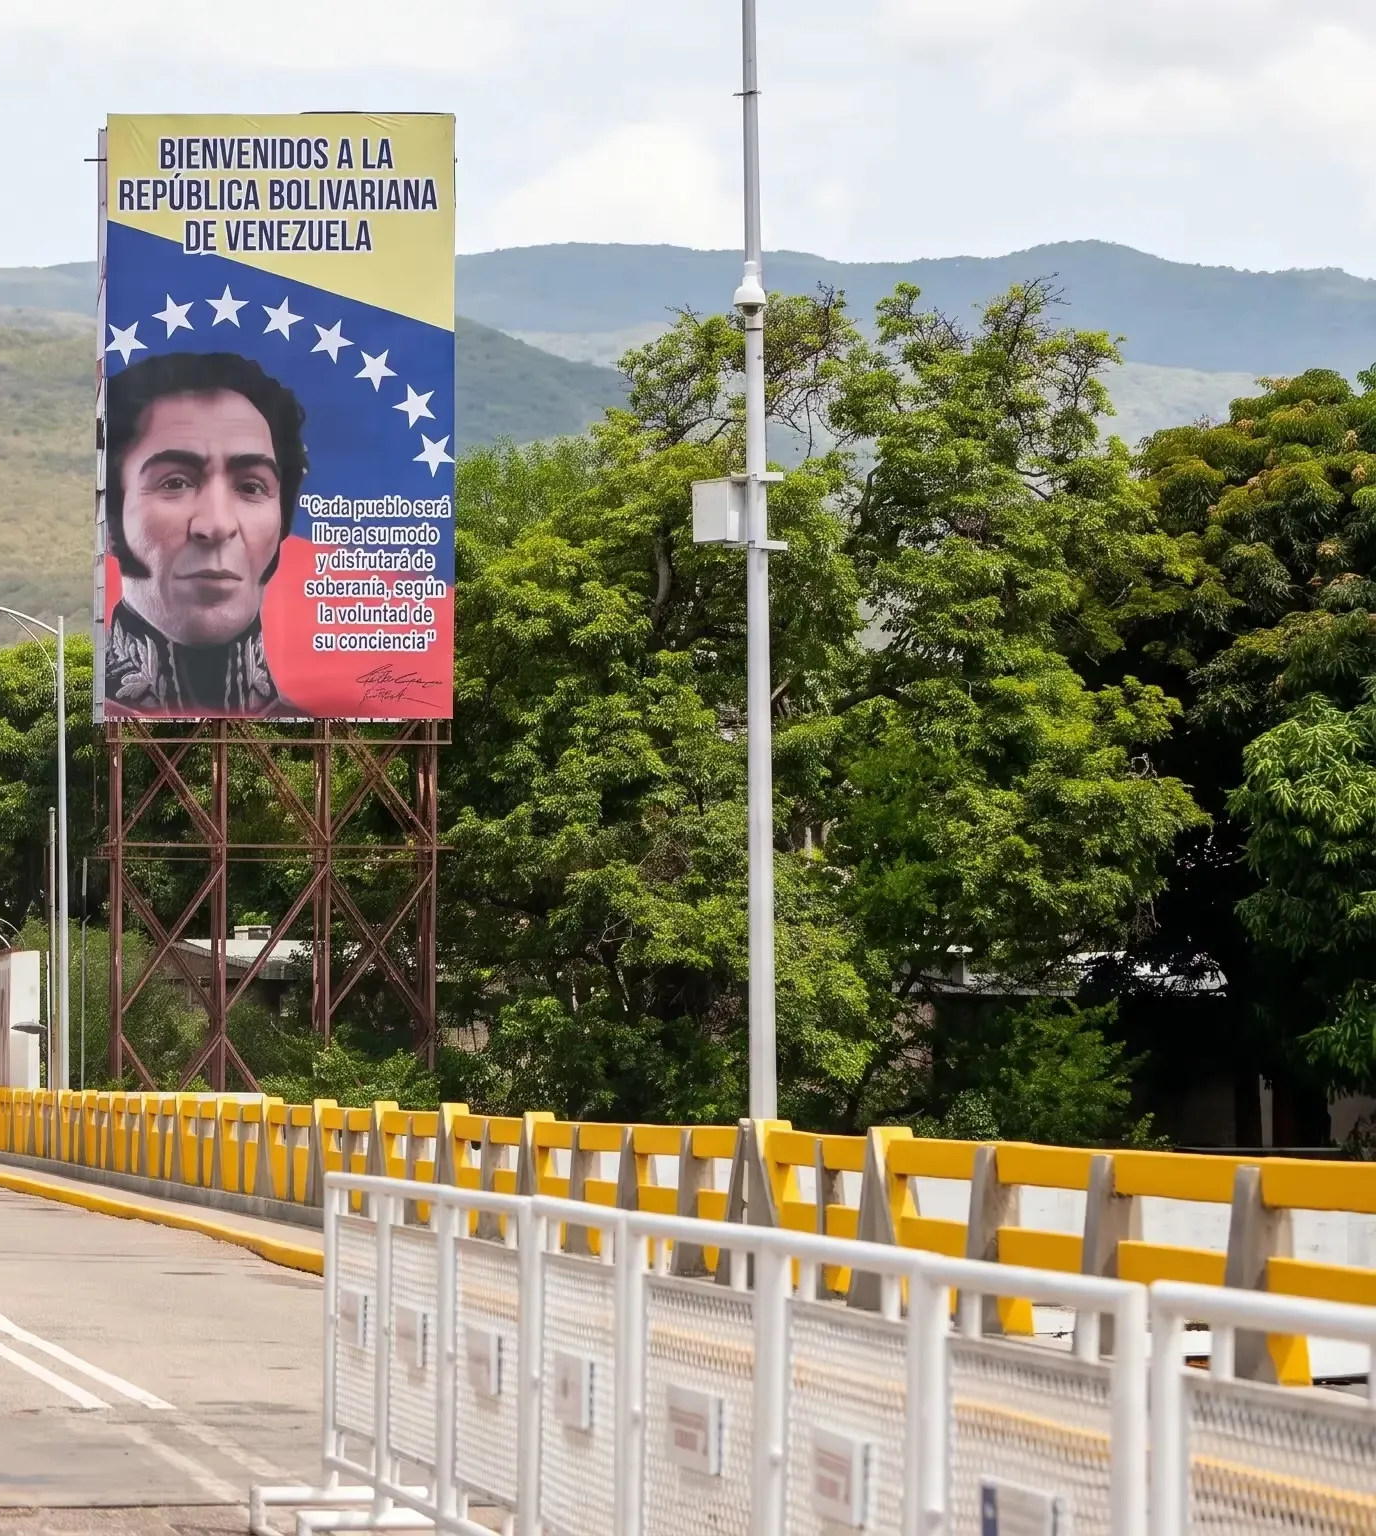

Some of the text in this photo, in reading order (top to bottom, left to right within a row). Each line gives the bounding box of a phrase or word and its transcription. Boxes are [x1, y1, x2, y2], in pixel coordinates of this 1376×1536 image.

[159, 138, 393, 170] BIENVENIDOS A LA
[118, 173, 437, 210] REPÚBLICA BOLIVARIANA
[185, 220, 372, 251] DE VENEZUELA
[355, 497, 410, 520] pueblo
[415, 497, 450, 516] será
[353, 529, 363, 542] a
[367, 529, 387, 542] su
[392, 524, 438, 542] modo
[317, 550, 434, 573] y disfrutará de
[306, 577, 445, 600] soberanía, según
[319, 604, 433, 622] la voluntad de
[314, 631, 435, 649] su conciencia"
